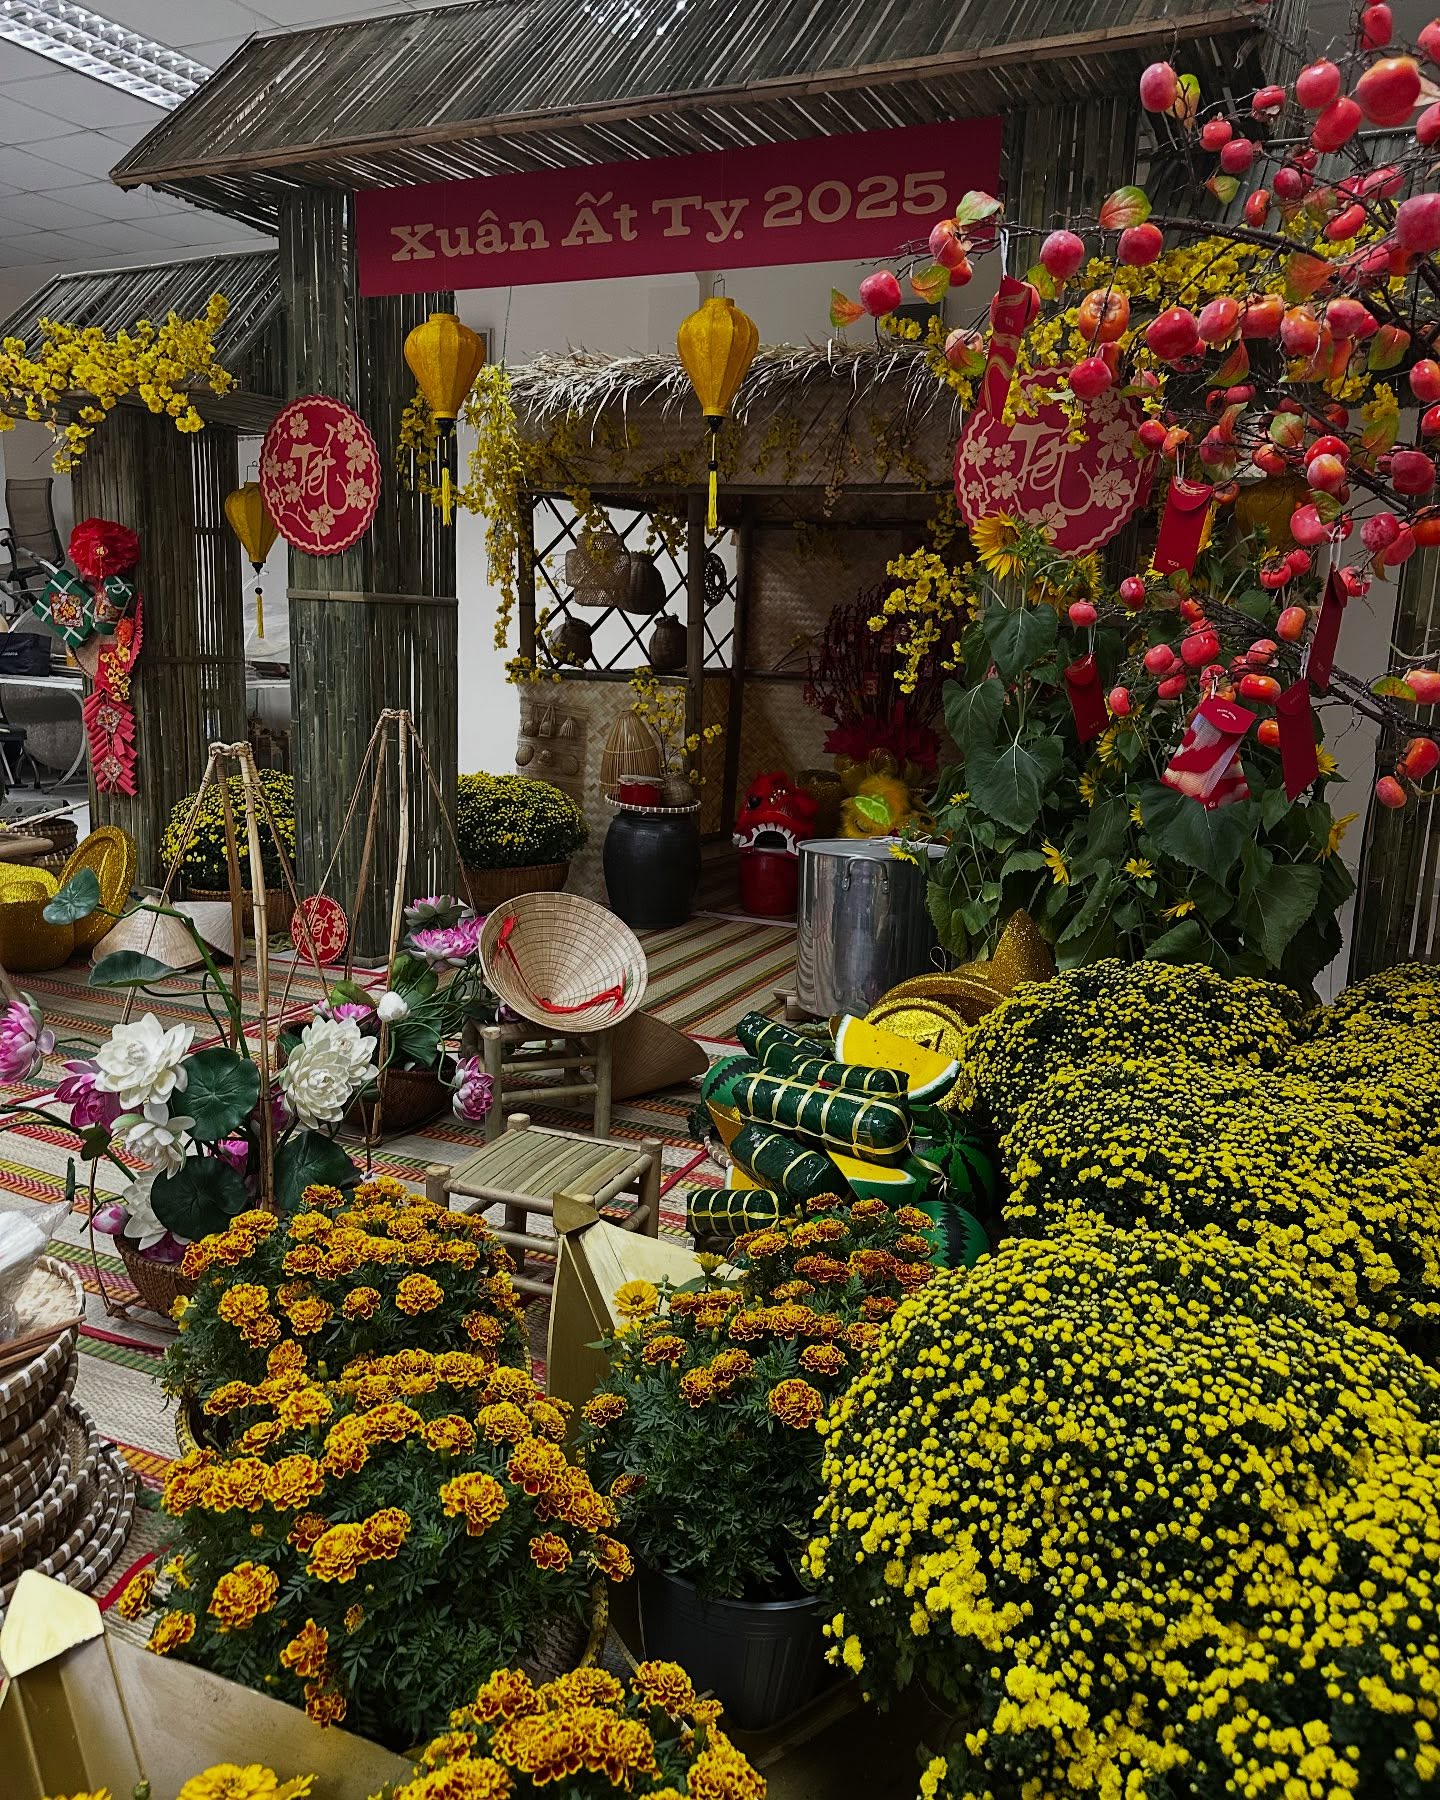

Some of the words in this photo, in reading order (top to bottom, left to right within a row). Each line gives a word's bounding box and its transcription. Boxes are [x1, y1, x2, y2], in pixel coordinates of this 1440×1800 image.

[390, 210, 549, 262] Xuân
[561, 191, 638, 247] Ất
[763, 170, 948, 228] 2025
[289, 422, 349, 516] Tết
